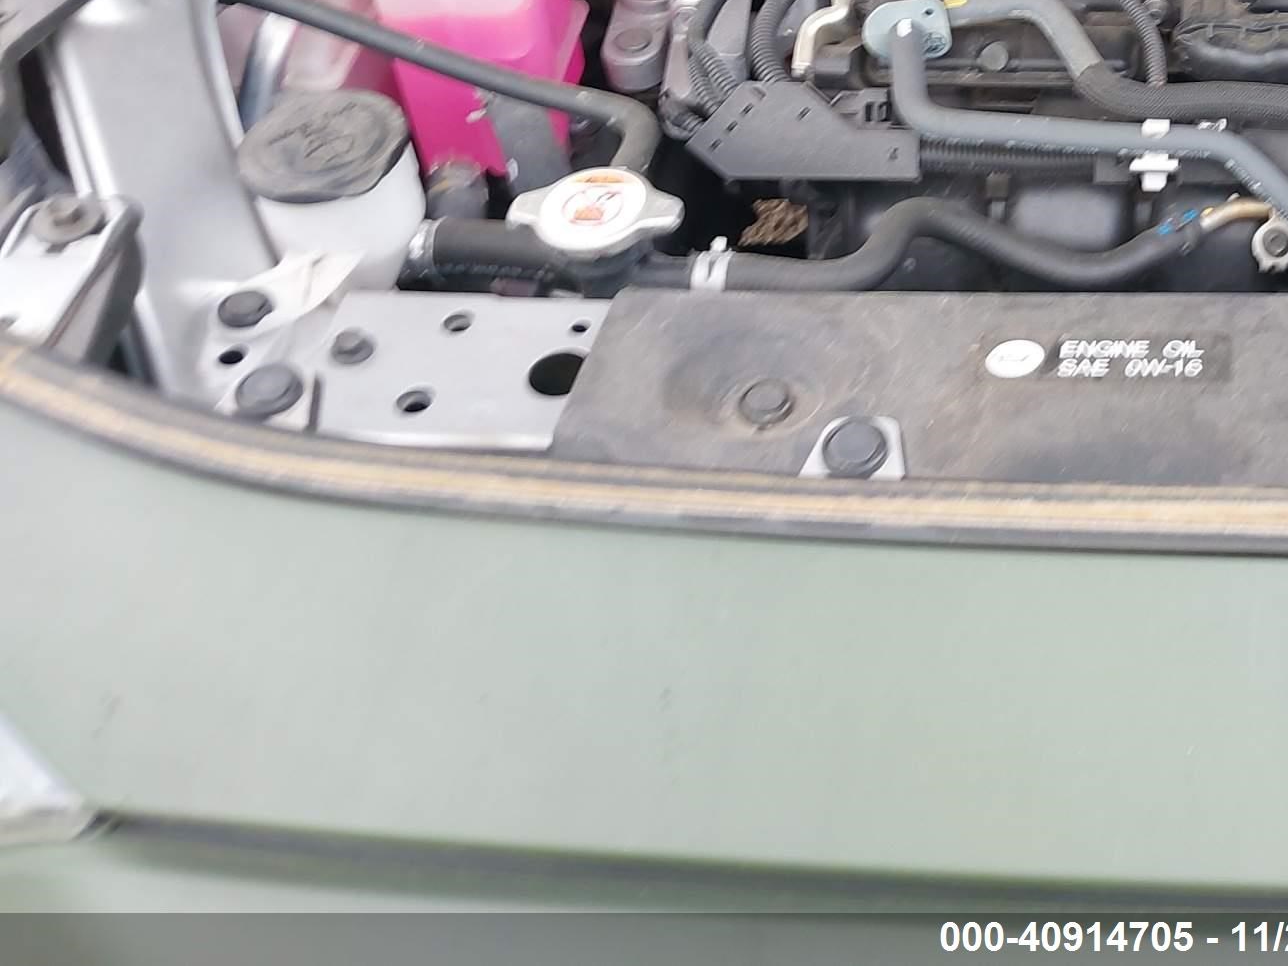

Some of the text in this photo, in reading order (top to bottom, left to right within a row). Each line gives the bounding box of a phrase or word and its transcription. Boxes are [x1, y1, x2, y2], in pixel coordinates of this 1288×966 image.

[1058, 339, 1205, 359] ENGINE OIL
[1057, 359, 1110, 378] SAE
